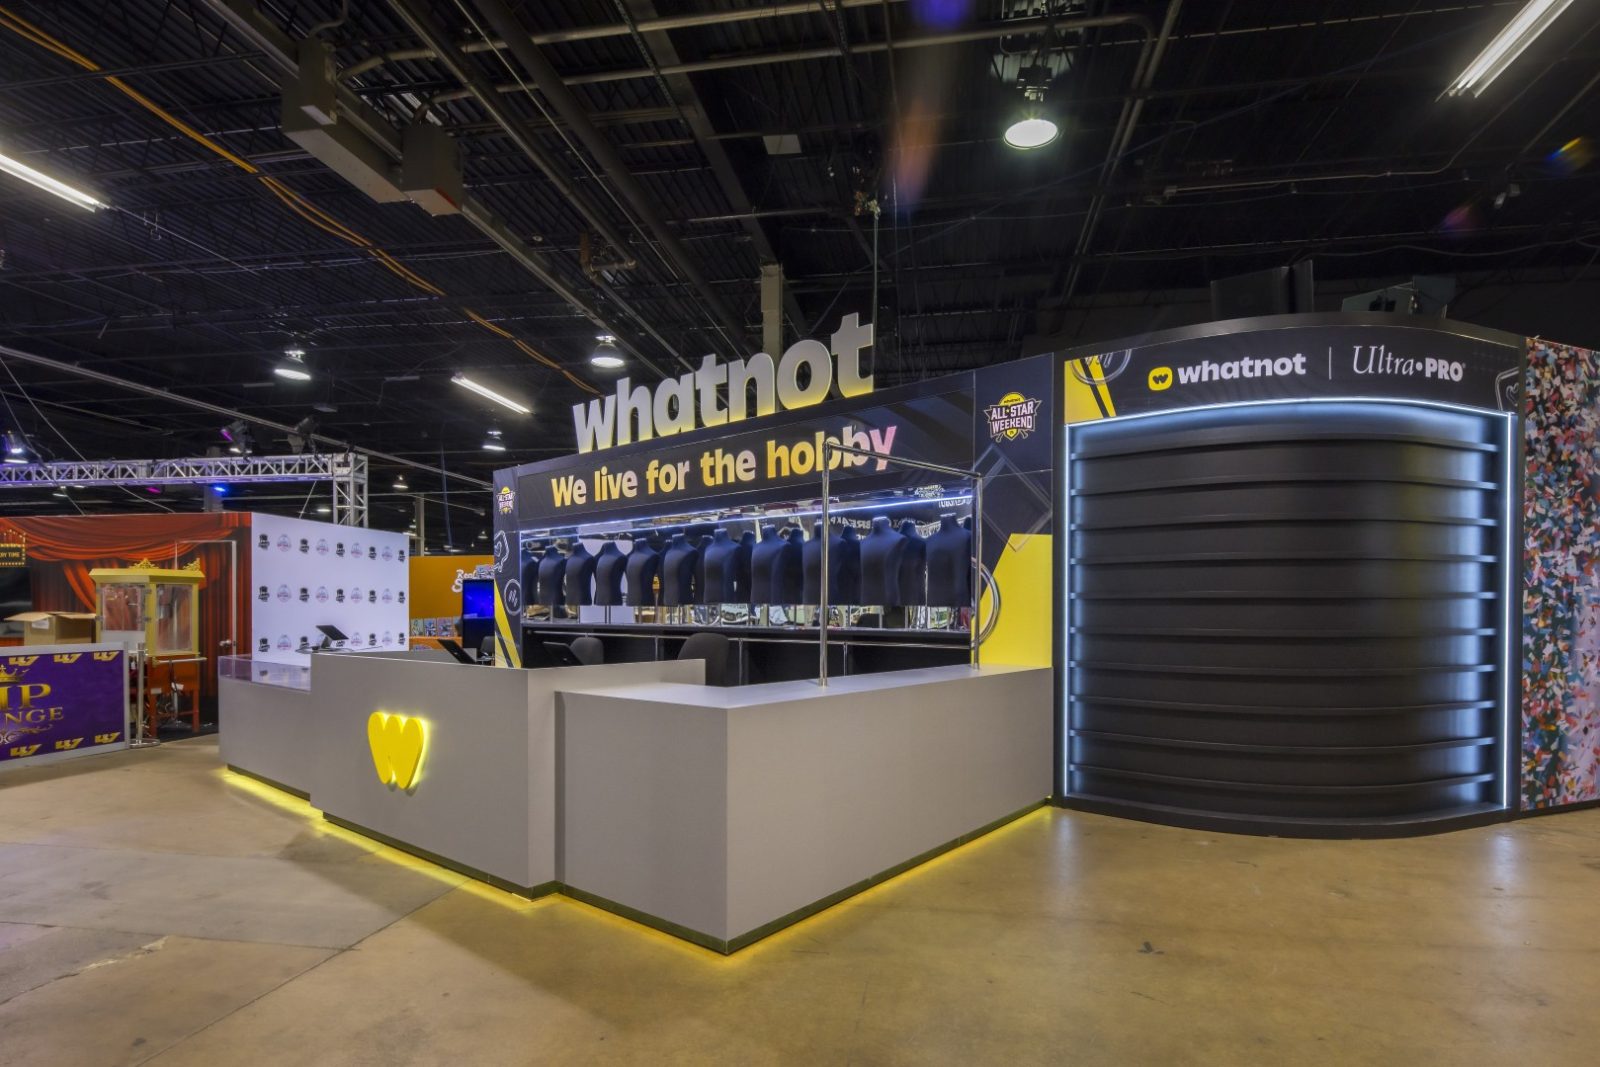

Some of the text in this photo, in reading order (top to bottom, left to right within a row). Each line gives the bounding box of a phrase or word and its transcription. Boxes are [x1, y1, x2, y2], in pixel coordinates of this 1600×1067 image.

[572, 312, 874, 455] whatnot
[1177, 353, 1307, 384] whatnot
[992, 415, 1033, 434] WEEKEND
[1010, 401, 1034, 418] STAR
[551, 475, 587, 508] We
[594, 466, 638, 502] live
[646, 459, 690, 495] for
[700, 448, 756, 487] the
[767, 425, 897, 478] hobby
